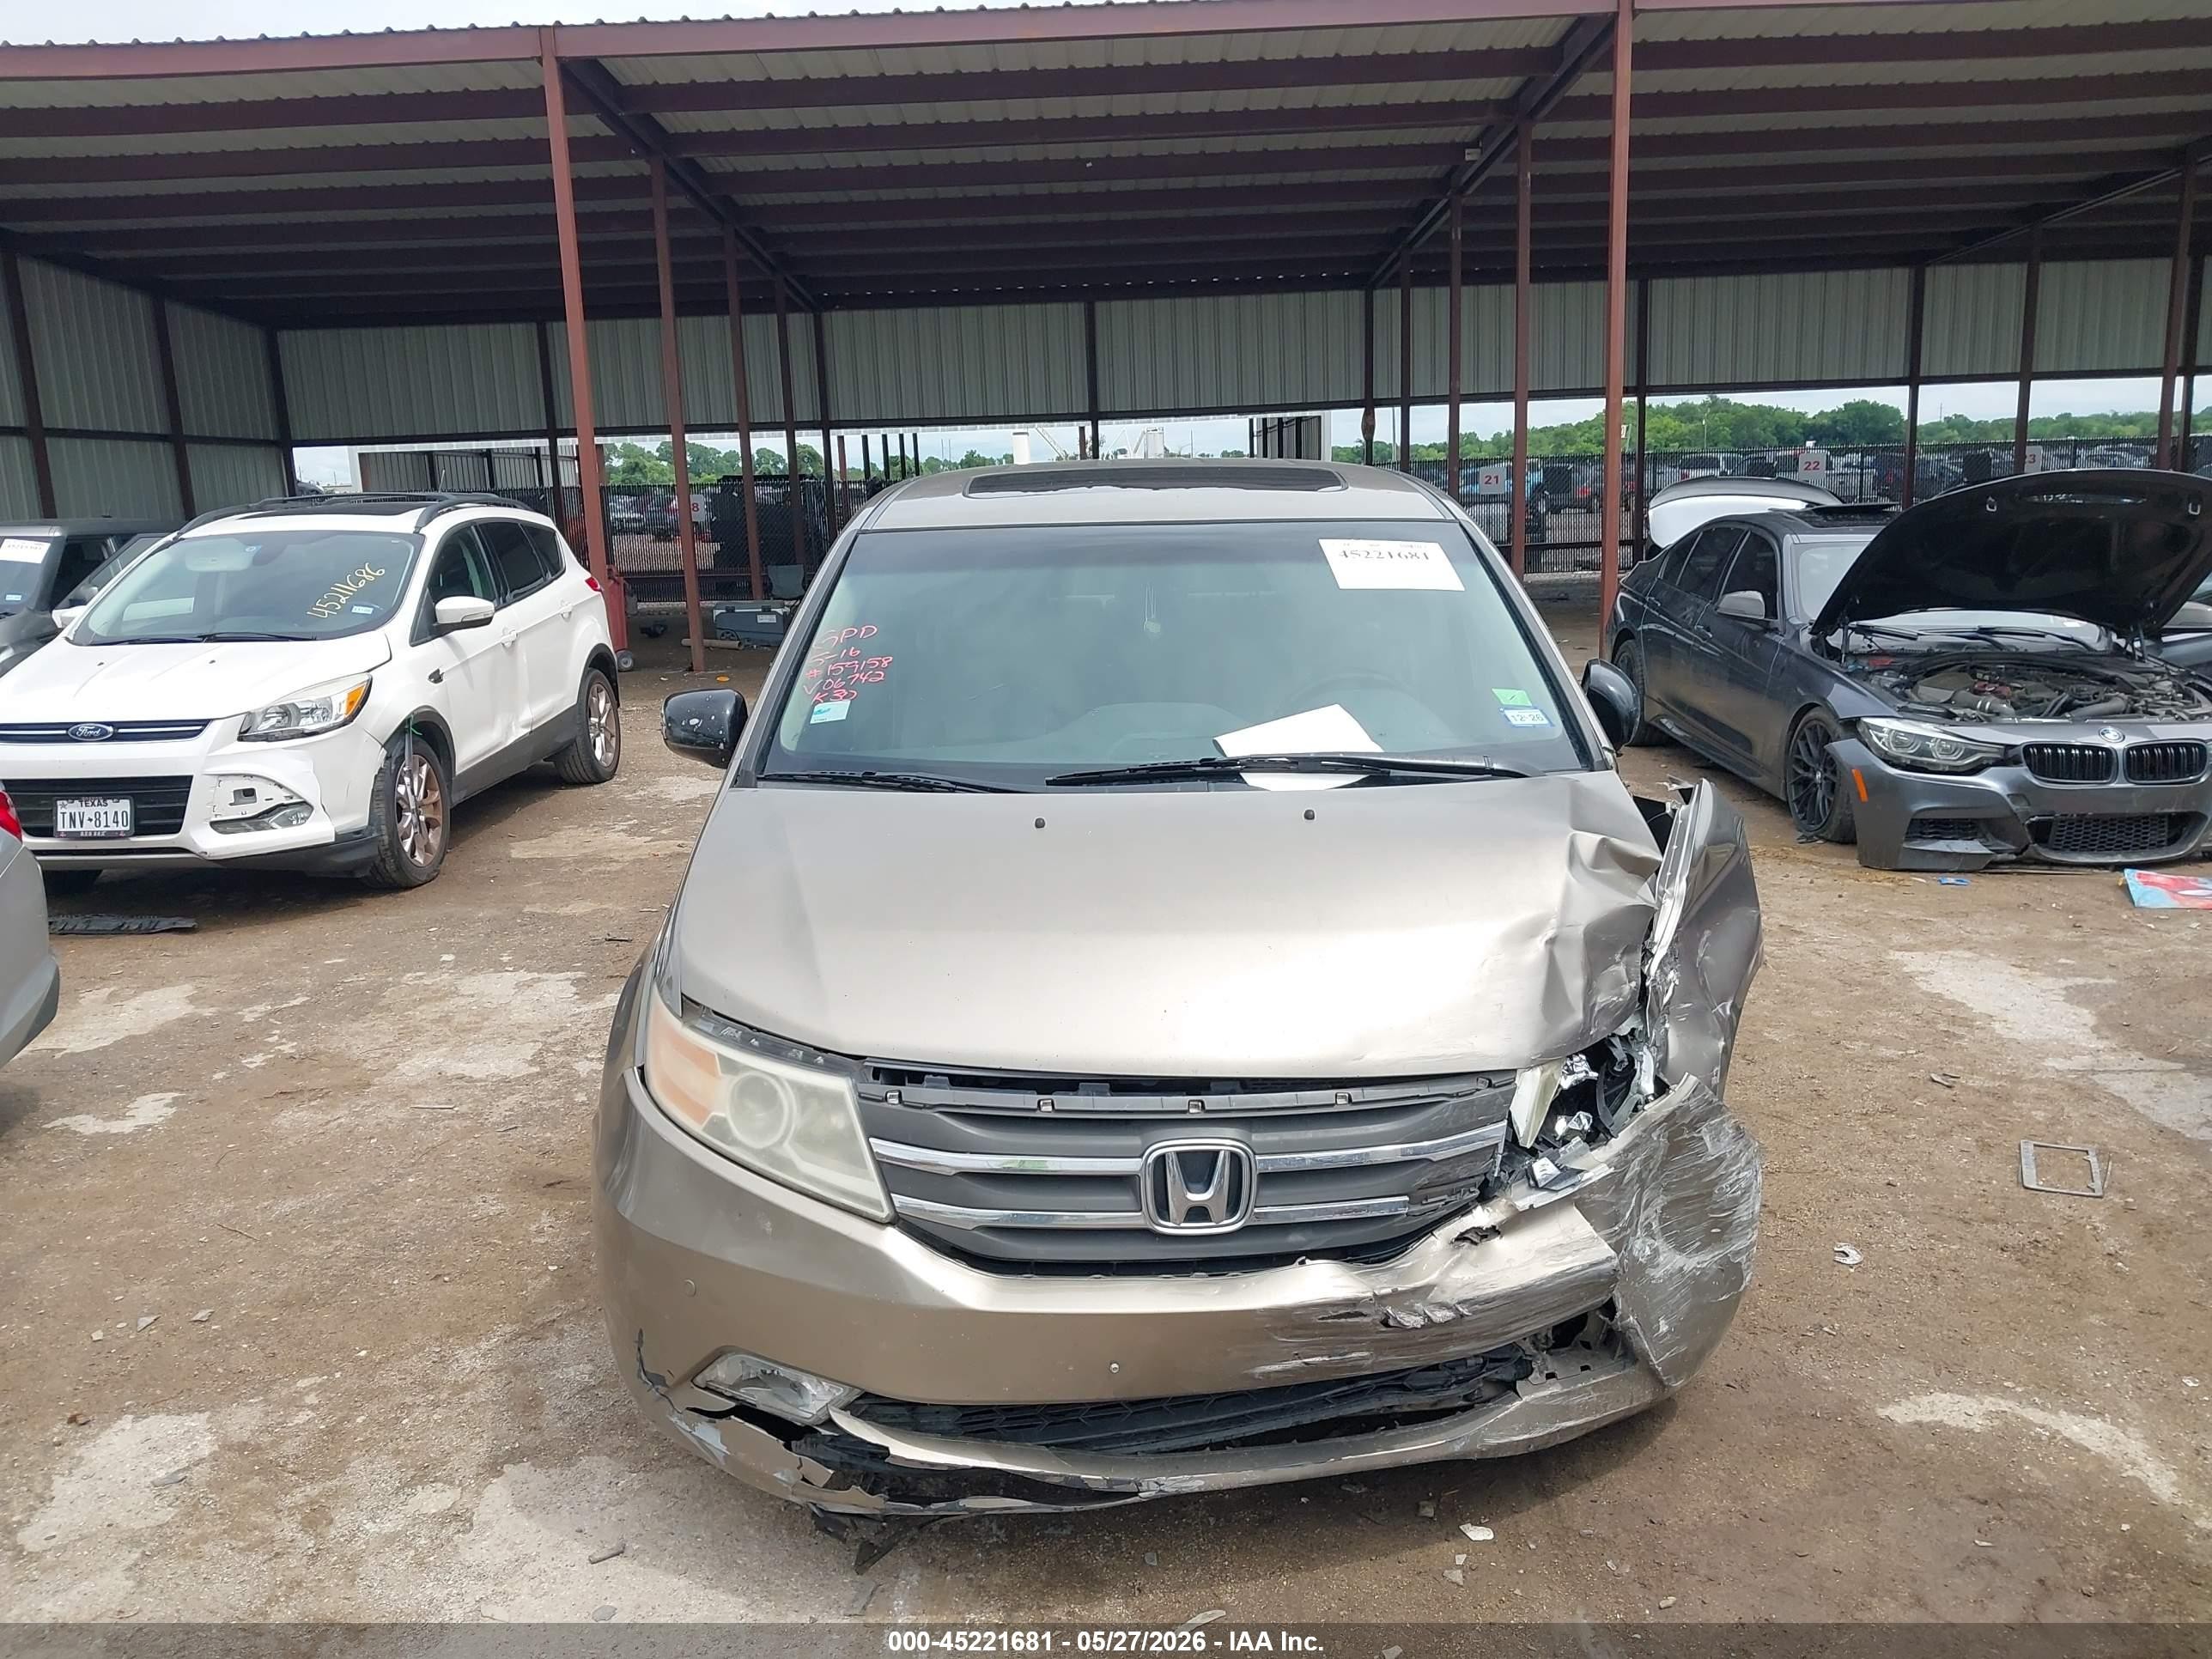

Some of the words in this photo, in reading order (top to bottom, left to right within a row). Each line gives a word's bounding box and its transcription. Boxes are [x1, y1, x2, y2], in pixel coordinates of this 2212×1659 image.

[2028, 453, 2036, 464] 3
[1804, 461, 1820, 471] 22
[1484, 474, 1499, 485] 21
[691, 502, 700, 513] 8
[1338, 550, 1431, 561] 45221681
[306, 562, 386, 618] 45211686
[76, 726, 102, 737] Ford
[78, 799, 109, 808] TEXAS
